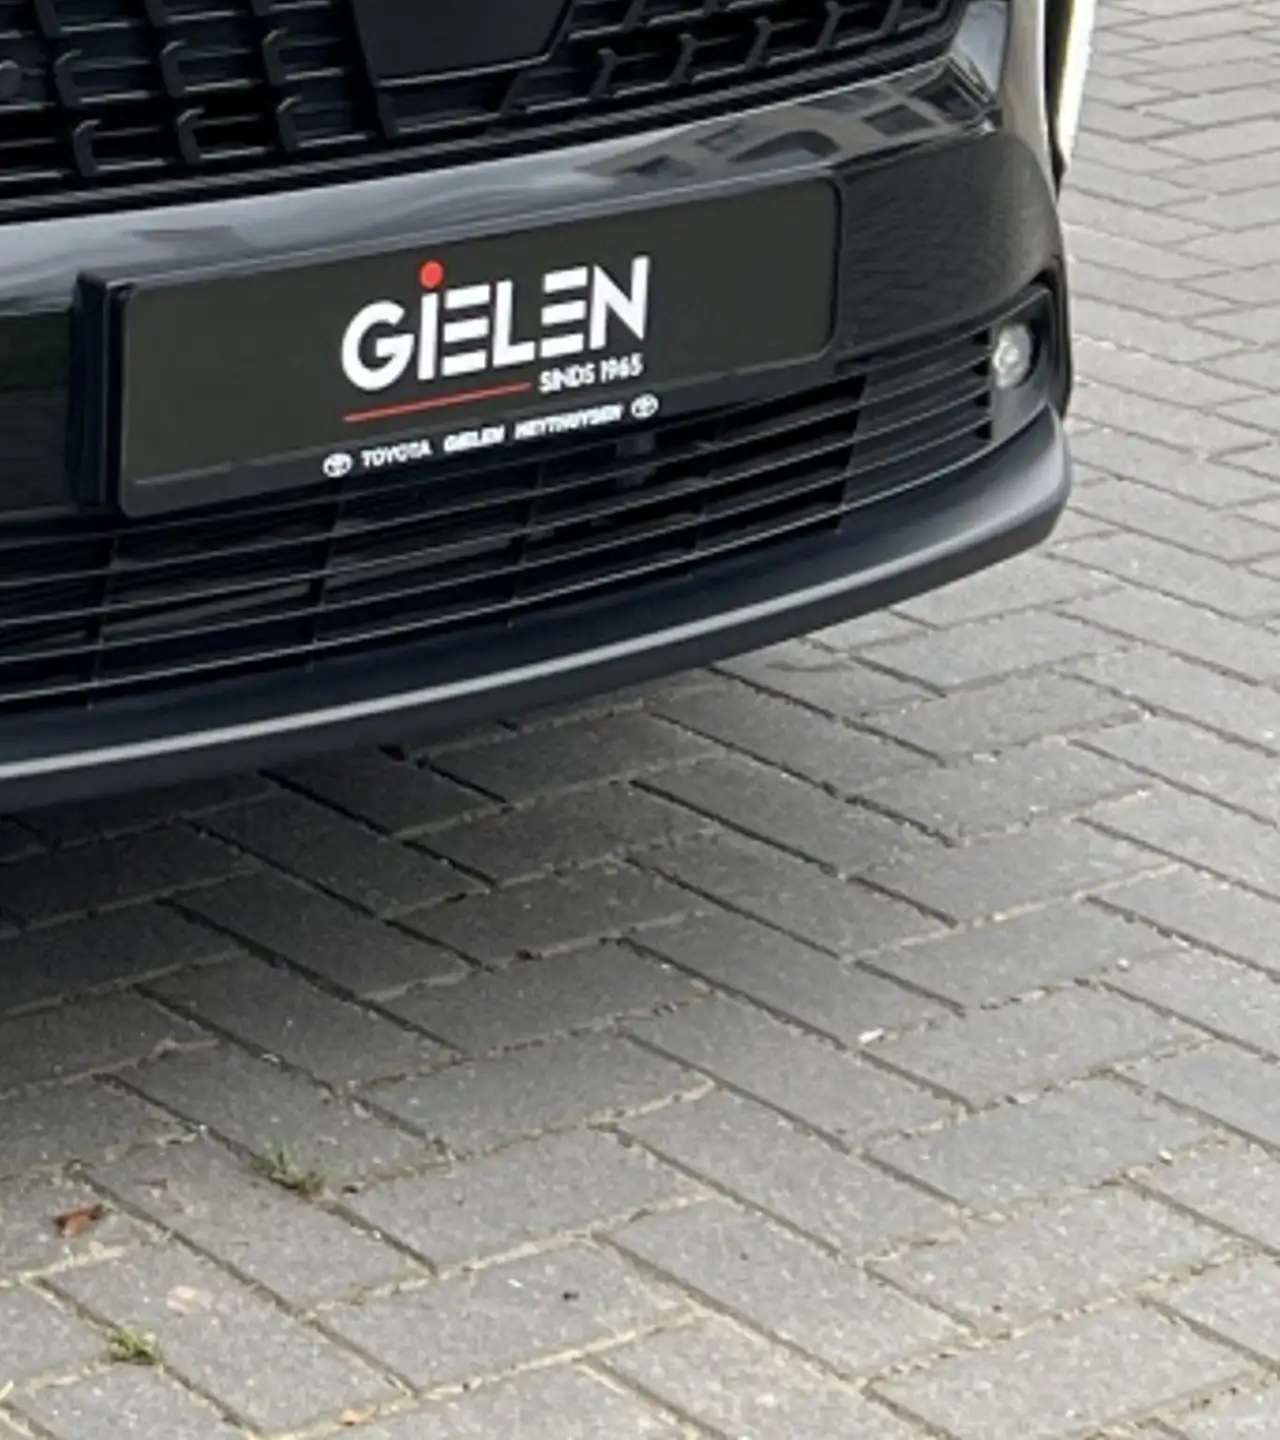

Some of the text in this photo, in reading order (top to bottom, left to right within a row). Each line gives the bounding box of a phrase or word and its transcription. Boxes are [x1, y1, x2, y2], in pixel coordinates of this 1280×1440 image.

[539, 352, 644, 393] SINDS 1965
[361, 438, 433, 468] TOYOTA
